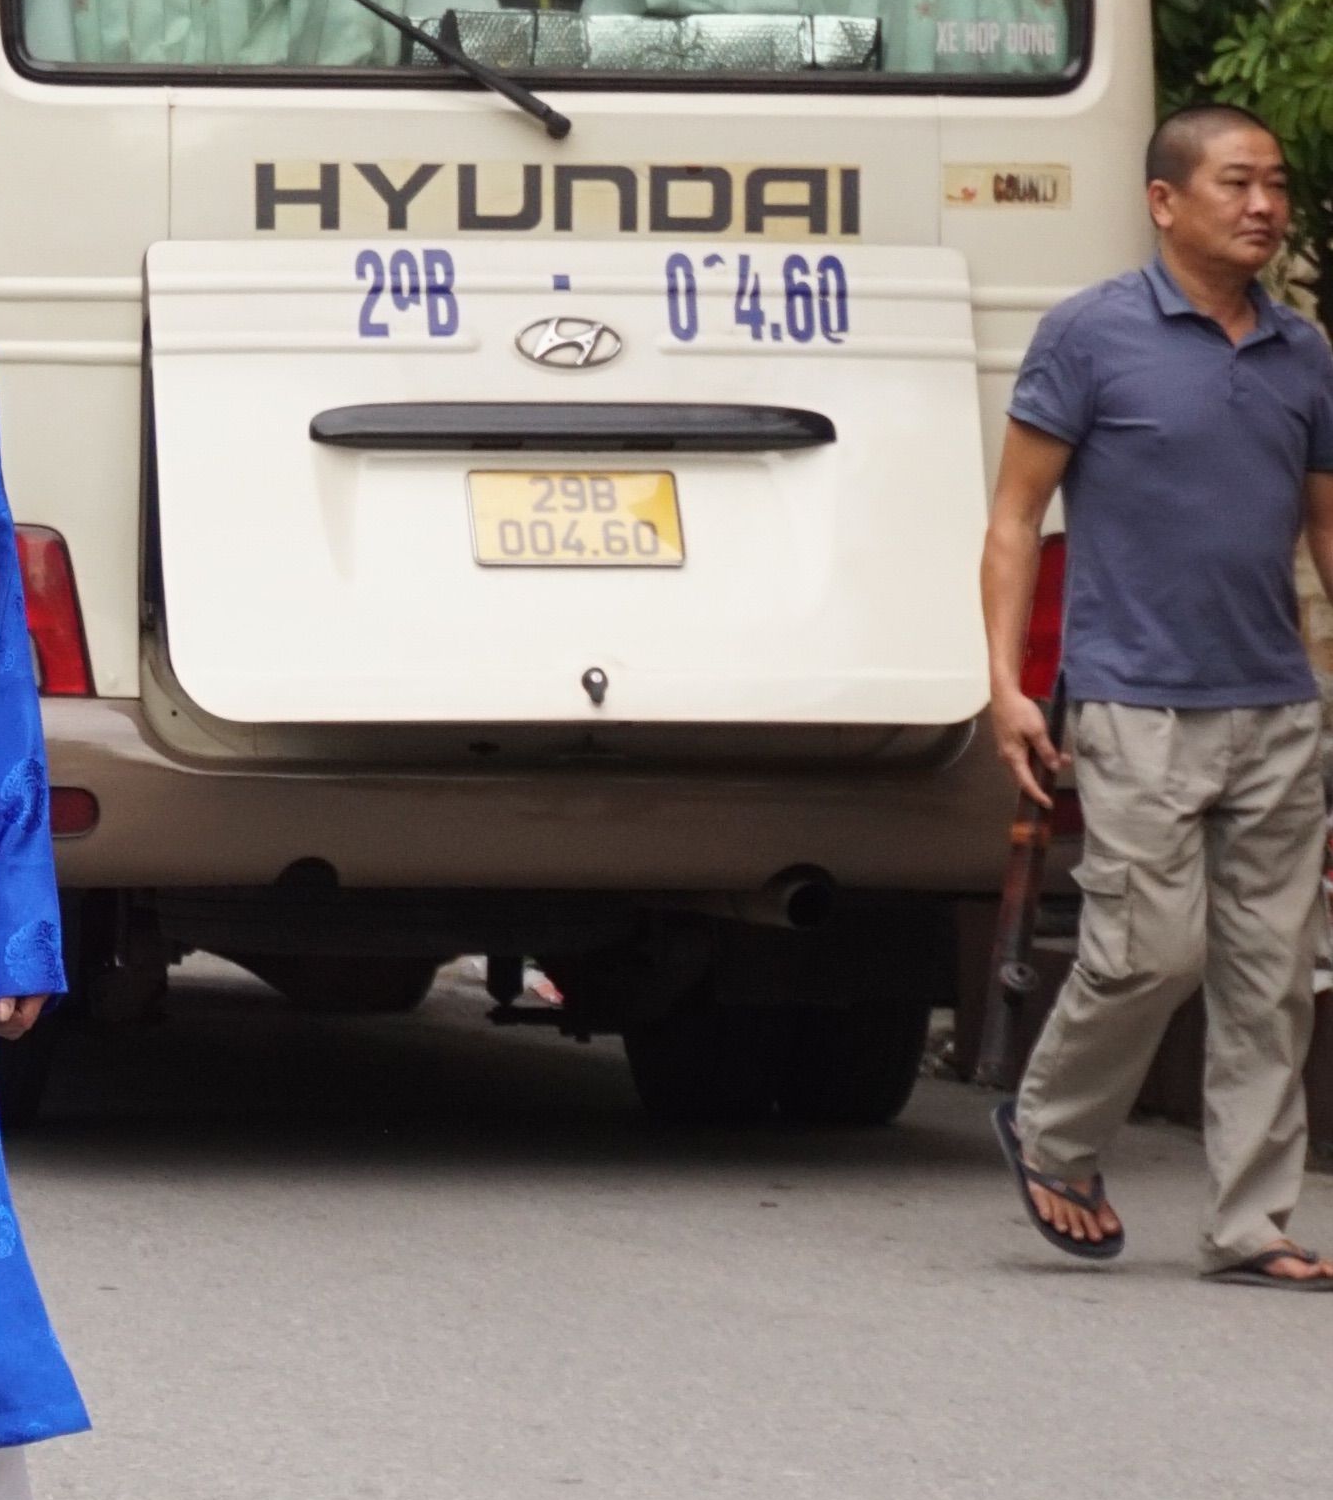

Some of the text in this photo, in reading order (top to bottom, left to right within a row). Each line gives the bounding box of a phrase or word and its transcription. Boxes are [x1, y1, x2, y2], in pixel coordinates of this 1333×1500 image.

[935, 21, 958, 56] XE
[254, 162, 861, 236] HYUNDAI
[664, 251, 851, 344] 04.60
[528, 475, 617, 514] 29B
[497, 519, 660, 557] 004.60
